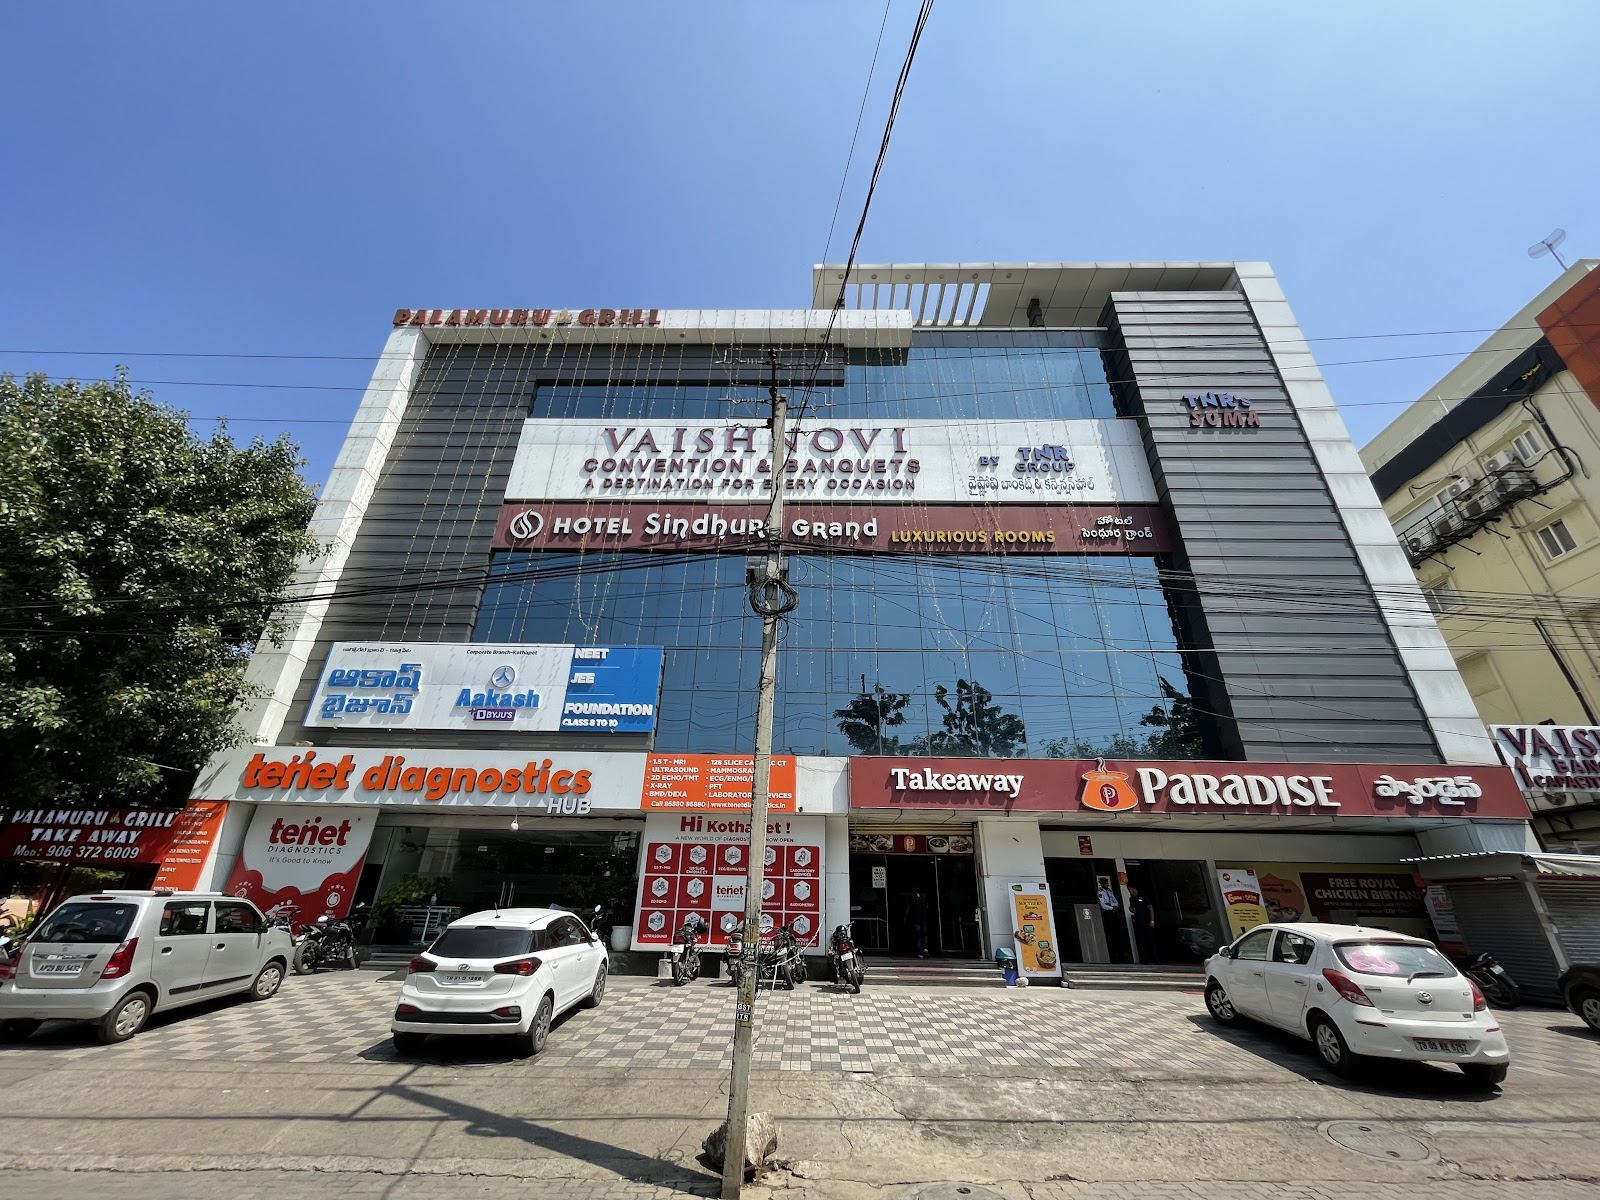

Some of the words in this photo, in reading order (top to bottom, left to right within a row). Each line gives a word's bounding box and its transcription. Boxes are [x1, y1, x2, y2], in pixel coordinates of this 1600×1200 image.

[391, 308, 552, 327] PALAMURU
[578, 309, 661, 327] GRILL
[1017, 444, 1069, 461] TNR
[584, 458, 744, 473] CONVENTION
[757, 458, 771, 473] &
[785, 458, 921, 474] BANQUETS
[980, 456, 999, 467] BY
[1015, 462, 1075, 473] GROUP
[585, 478, 594, 489] A
[603, 478, 714, 490] DESTINATION
[722, 478, 754, 490] FOR
[763, 478, 818, 490] EERY
[827, 478, 915, 490] OCCASION
[553, 516, 633, 535] HOTEL
[645, 513, 769, 540] Sindhur
[891, 530, 987, 544] LUXURIOUS
[995, 530, 1056, 544] ROOMS
[574, 648, 609, 659] NEET
[570, 672, 595, 684] JEE
[456, 688, 540, 708] Aakash
[486, 710, 513, 719] BYJU'S
[564, 702, 653, 716] FOUNDATION
[562, 718, 589, 727] CLASS
[596, 719, 608, 727] TO
[609, 719, 619, 727] 10
[243, 751, 355, 790] tenet
[362, 755, 592, 800] diagnostics
[891, 767, 1024, 798] Takeaway
[547, 797, 592, 815] HUB
[124, 811, 175, 828] GRILL
[680, 815, 703, 832] Hi
[707, 820, 781, 834] Kothaet
[31, 828, 82, 843] TAKE
[87, 829, 142, 844] AWAY
[269, 816, 352, 846] tenet
[13, 845, 41, 857] Mob:
[46, 845, 73, 858] 906
[75, 846, 102, 859] 372
[104, 847, 140, 860] 6009
[267, 845, 342, 855] DIAGNOSTICS
[282, 856, 301, 864] Good
[312, 857, 332, 865] Know
[716, 884, 744, 895] tenet
[1328, 878, 1357, 888] FREE
[1360, 879, 1399, 889] ROYAL
[1314, 889, 1369, 899] CHICKEN
[738, 1003, 750, 1011] GST
[736, 1013, 749, 1021] ITR
